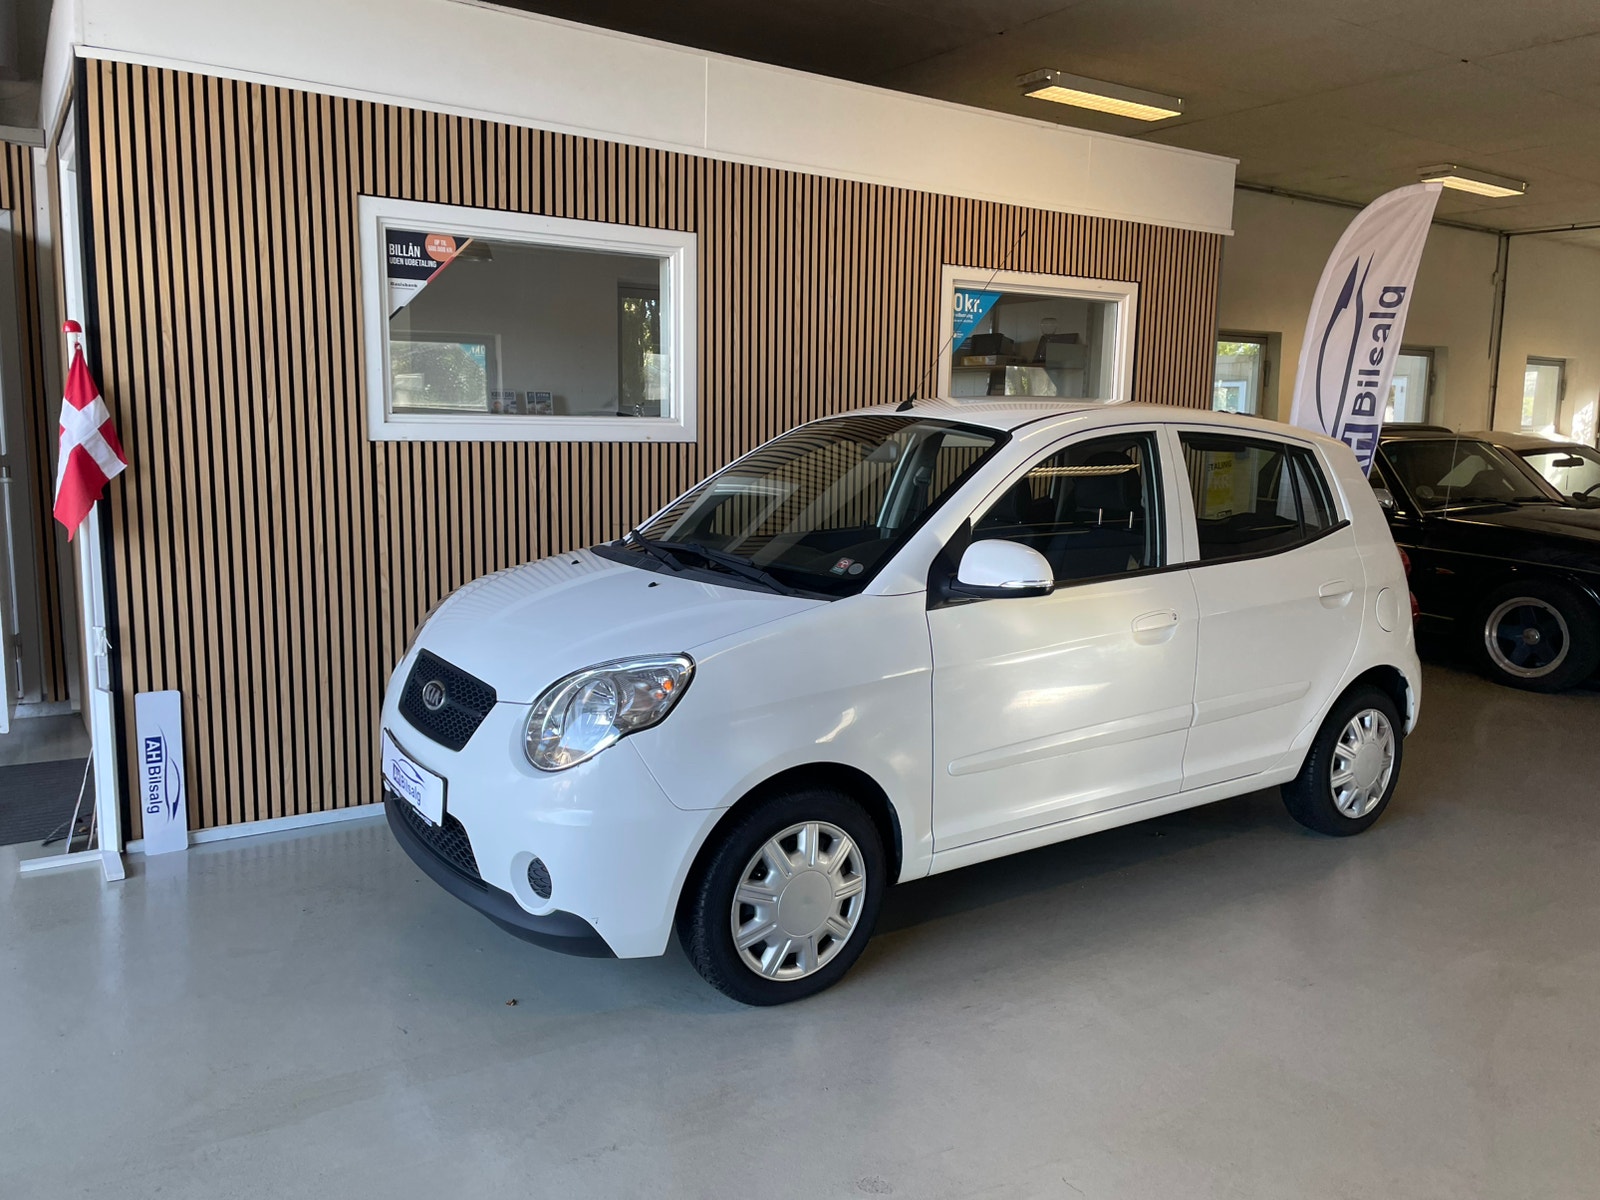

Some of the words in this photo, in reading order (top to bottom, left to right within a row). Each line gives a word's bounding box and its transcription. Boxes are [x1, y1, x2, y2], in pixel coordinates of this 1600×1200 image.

[388, 242, 421, 257] BILLÅN
[389, 257, 404, 265] UDEN
[404, 258, 437, 268] UDBETALING
[1351, 286, 1407, 417] Bilsalg
[145, 739, 162, 762] AH
[147, 765, 163, 814] Bilsalg
